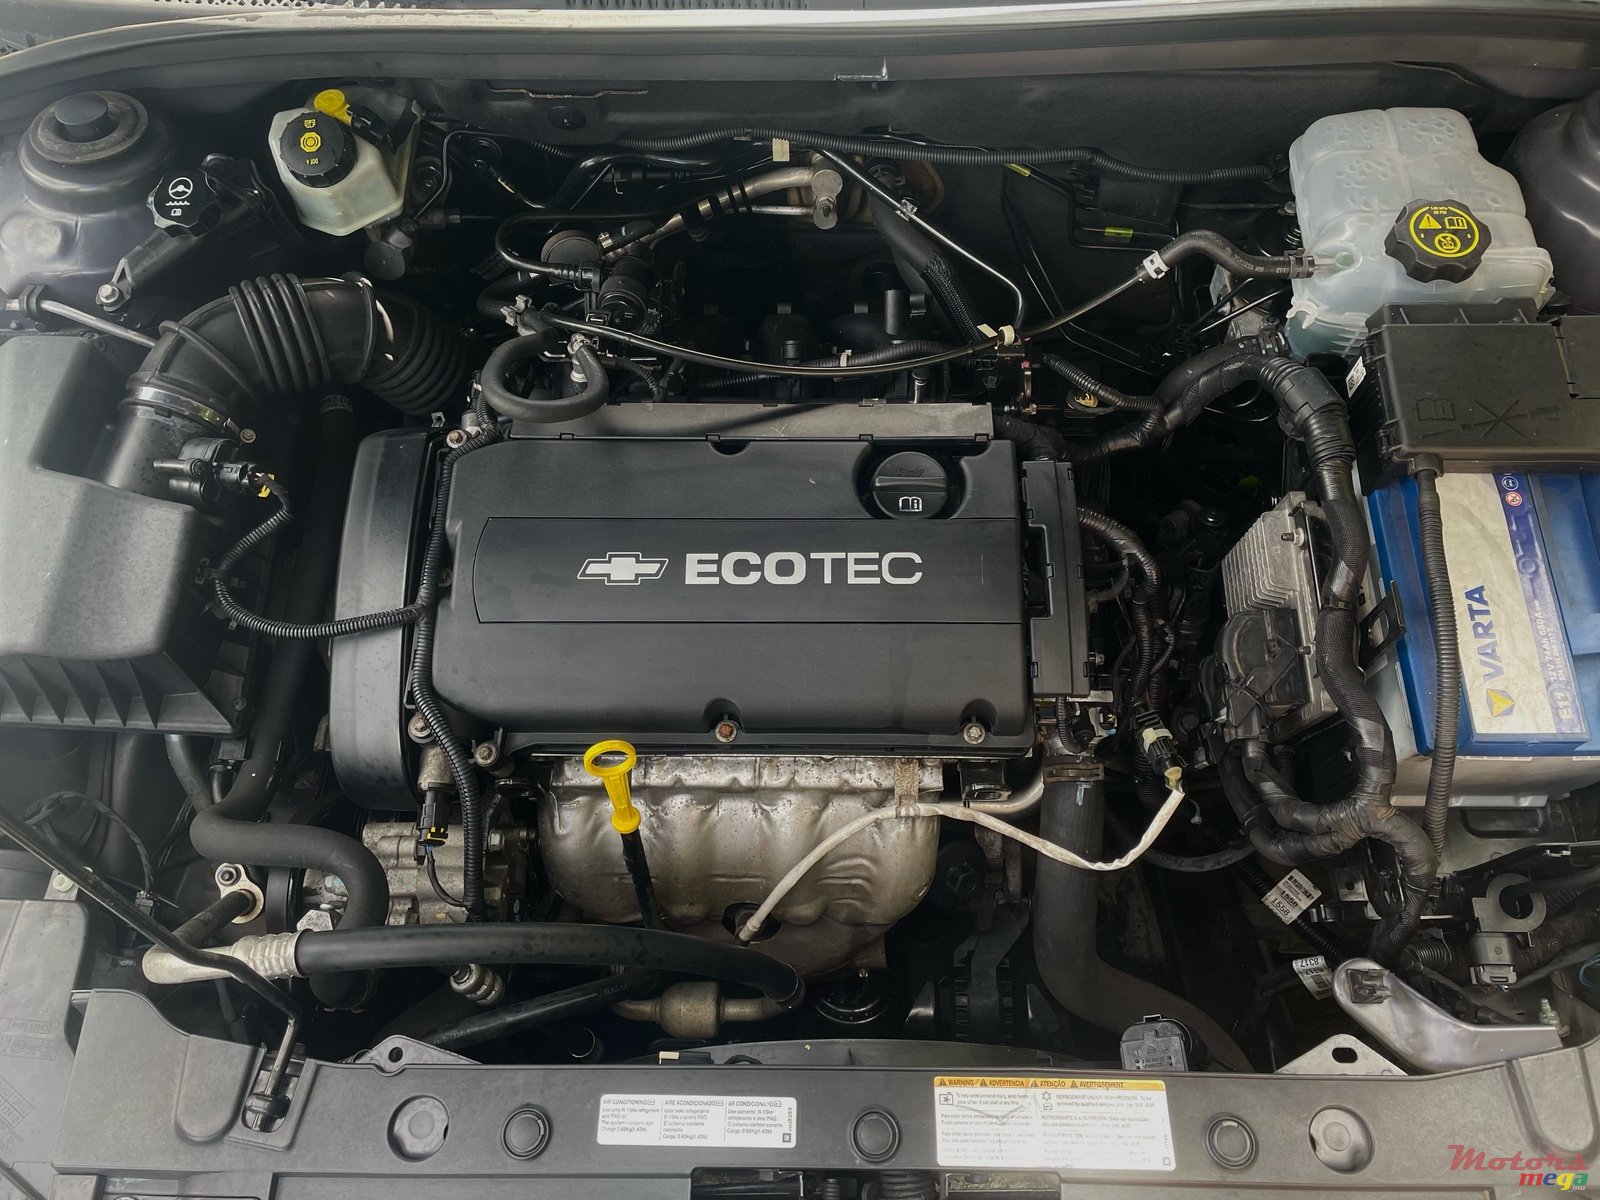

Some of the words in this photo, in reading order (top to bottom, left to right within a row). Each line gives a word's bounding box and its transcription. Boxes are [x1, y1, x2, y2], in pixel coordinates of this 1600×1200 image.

[685, 551, 923, 584] ECOTEC
[1465, 585, 1504, 683] VARTA
[1272, 898, 1291, 916] 1558
[1280, 890, 1298, 907] 1558
[1300, 958, 1319, 968] 8317
